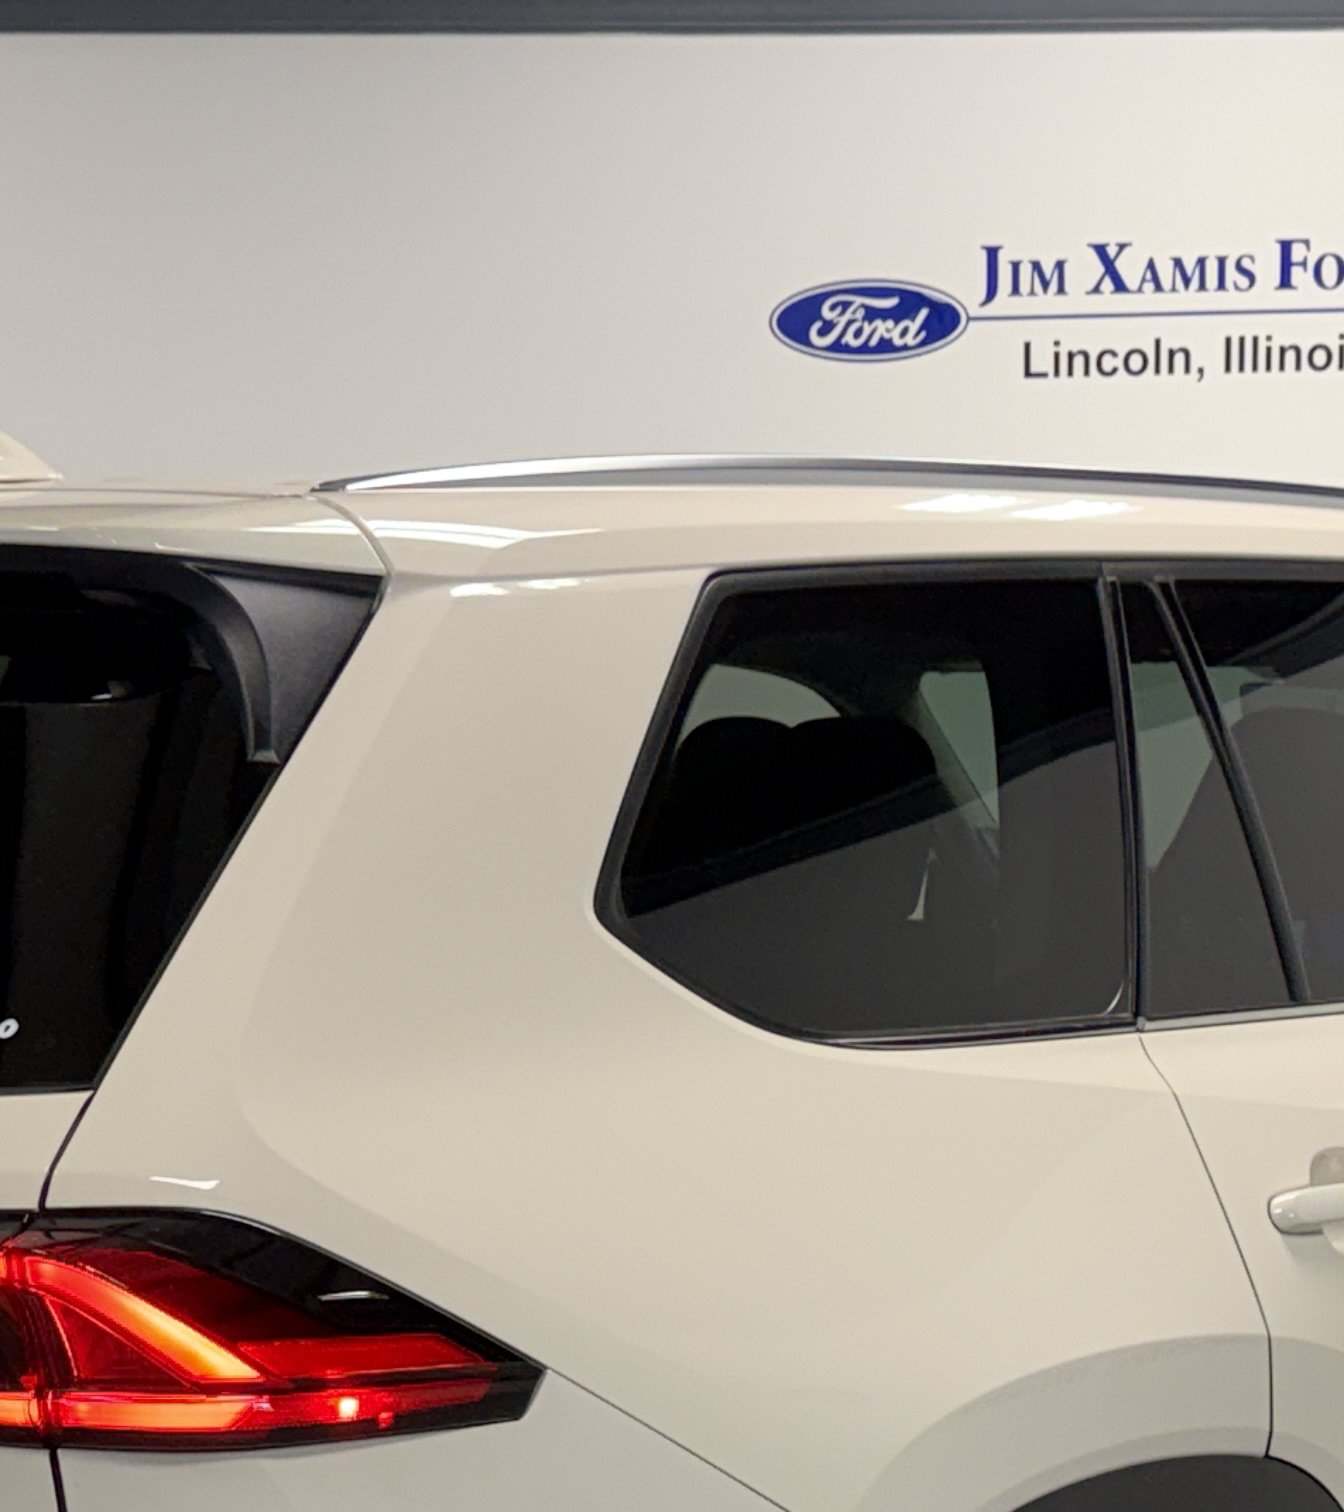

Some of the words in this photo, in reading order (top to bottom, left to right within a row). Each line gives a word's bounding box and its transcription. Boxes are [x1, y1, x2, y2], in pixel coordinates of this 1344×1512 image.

[978, 244, 1069, 308] JIM
[1086, 241, 1256, 298] XAMIS
[807, 293, 929, 350] Ford
[1022, 338, 1207, 383] Lincoln,
